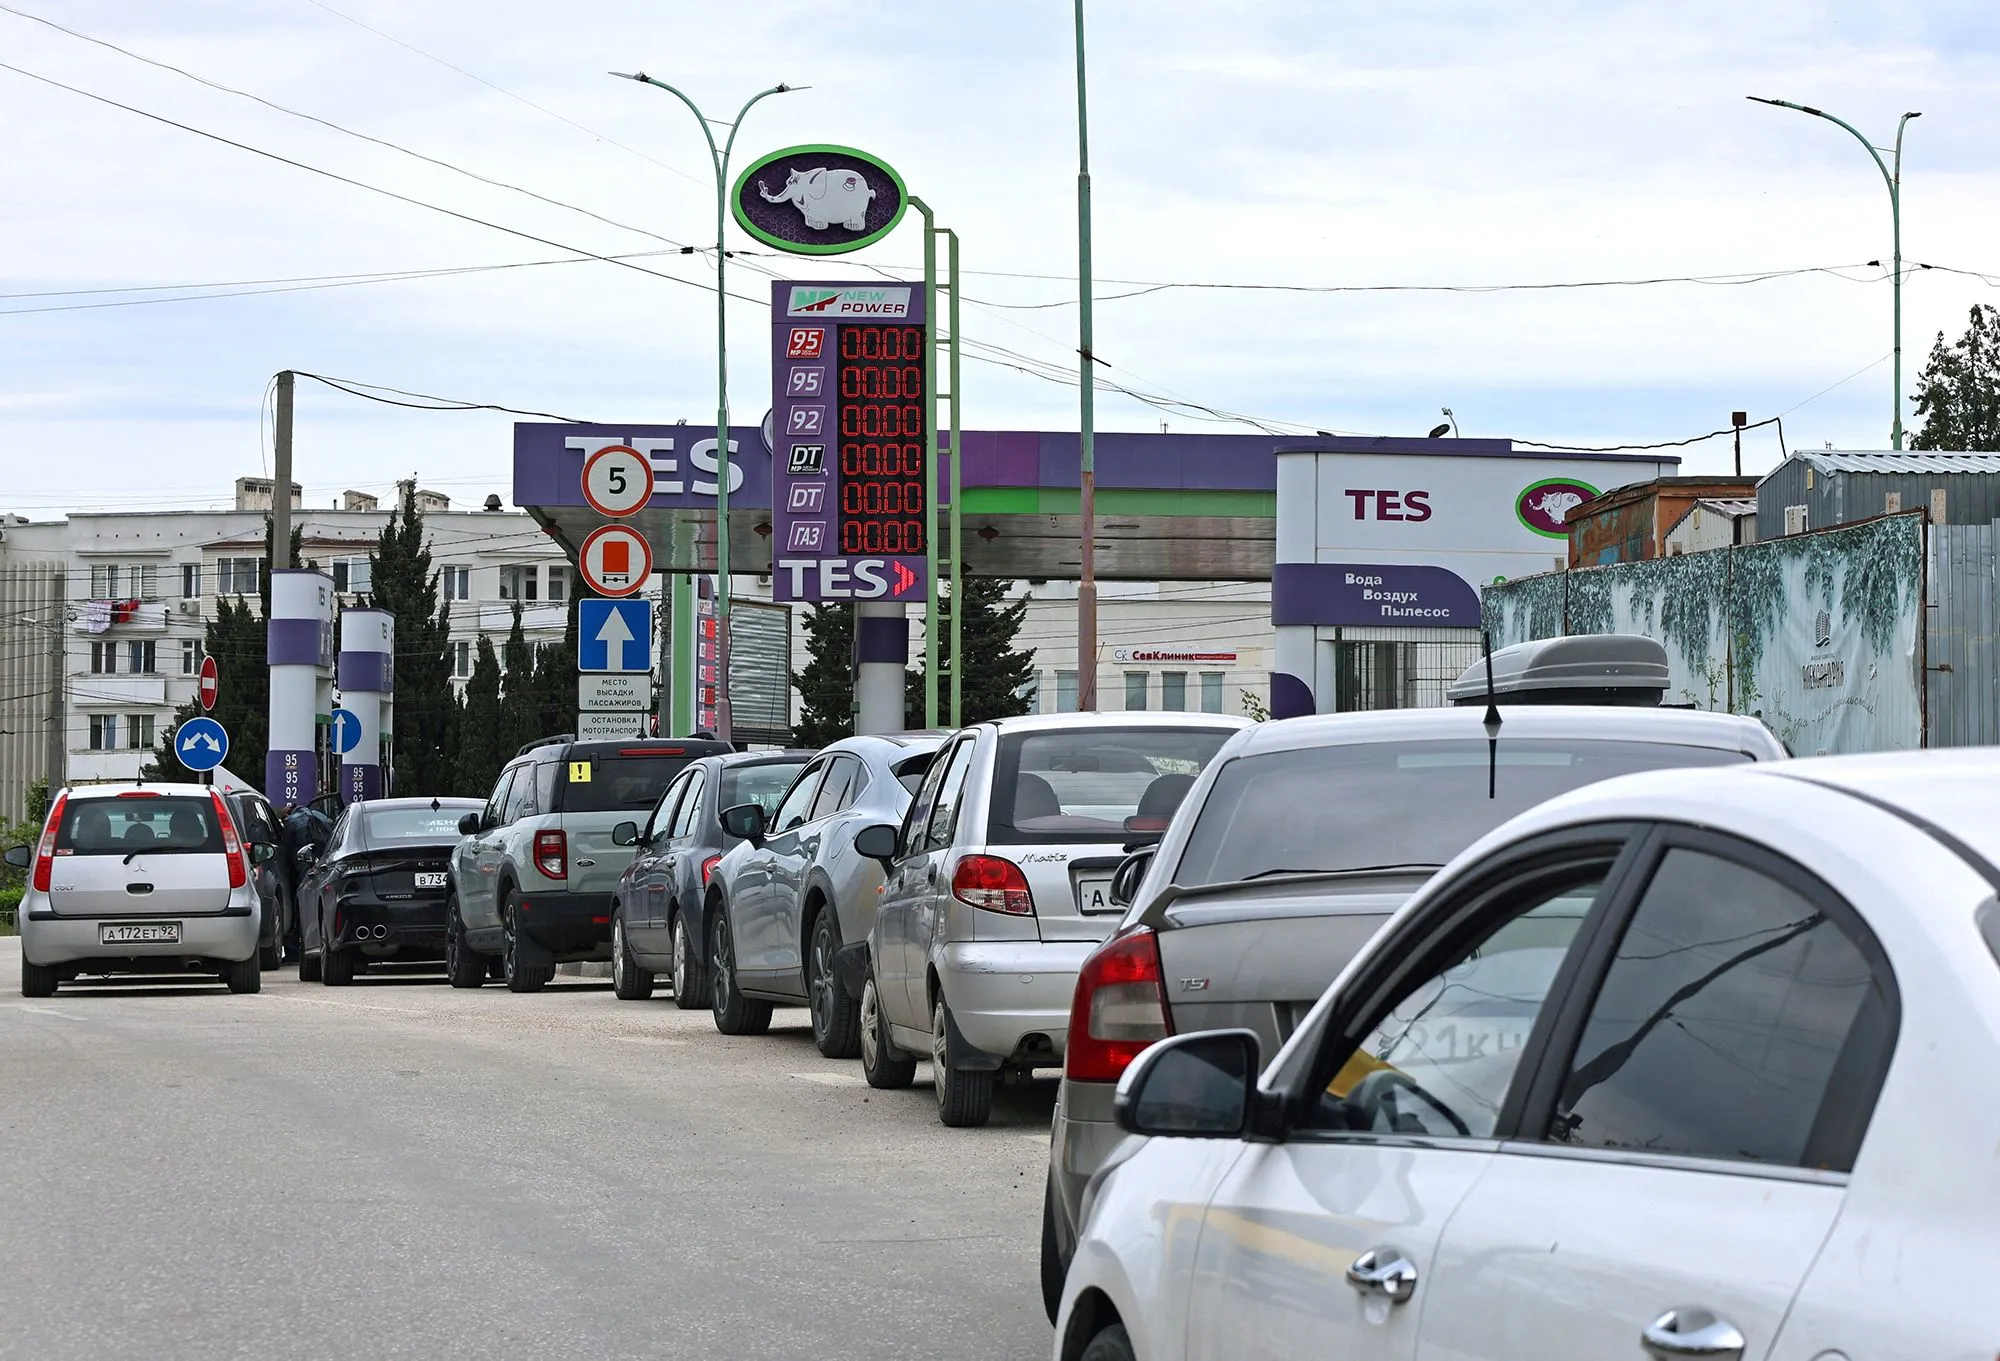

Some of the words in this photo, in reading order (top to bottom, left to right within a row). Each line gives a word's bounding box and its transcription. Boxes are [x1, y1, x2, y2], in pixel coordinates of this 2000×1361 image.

[843, 291, 885, 301] NEW
[841, 303, 905, 313] POWER
[793, 331, 818, 350] 95
[842, 328, 921, 360] 00.00
[793, 372, 819, 392] 95
[842, 366, 921, 399] 00.00
[793, 410, 819, 430] 92
[842, 405, 921, 437] 00.00
[793, 447, 822, 465] DT
[842, 443, 921, 476] 00.00
[609, 467, 627, 495] 5
[792, 488, 821, 507] DT
[843, 482, 922, 514] 00.00
[1344, 489, 1432, 522] TES
[794, 527, 820, 546] ГАЗ
[843, 521, 922, 553] 00.00
[778, 559, 888, 599] TES
[1345, 573, 1382, 586] Вода
[1363, 589, 1418, 603] Воздух
[1381, 605, 1450, 617] Пылесос
[285, 754, 298, 766] 95
[285, 771, 298, 783] 95
[353, 767, 364, 778] 95
[285, 786, 298, 799] 92
[353, 782, 364, 792] 95
[1018, 853, 1067, 864] Matiz
